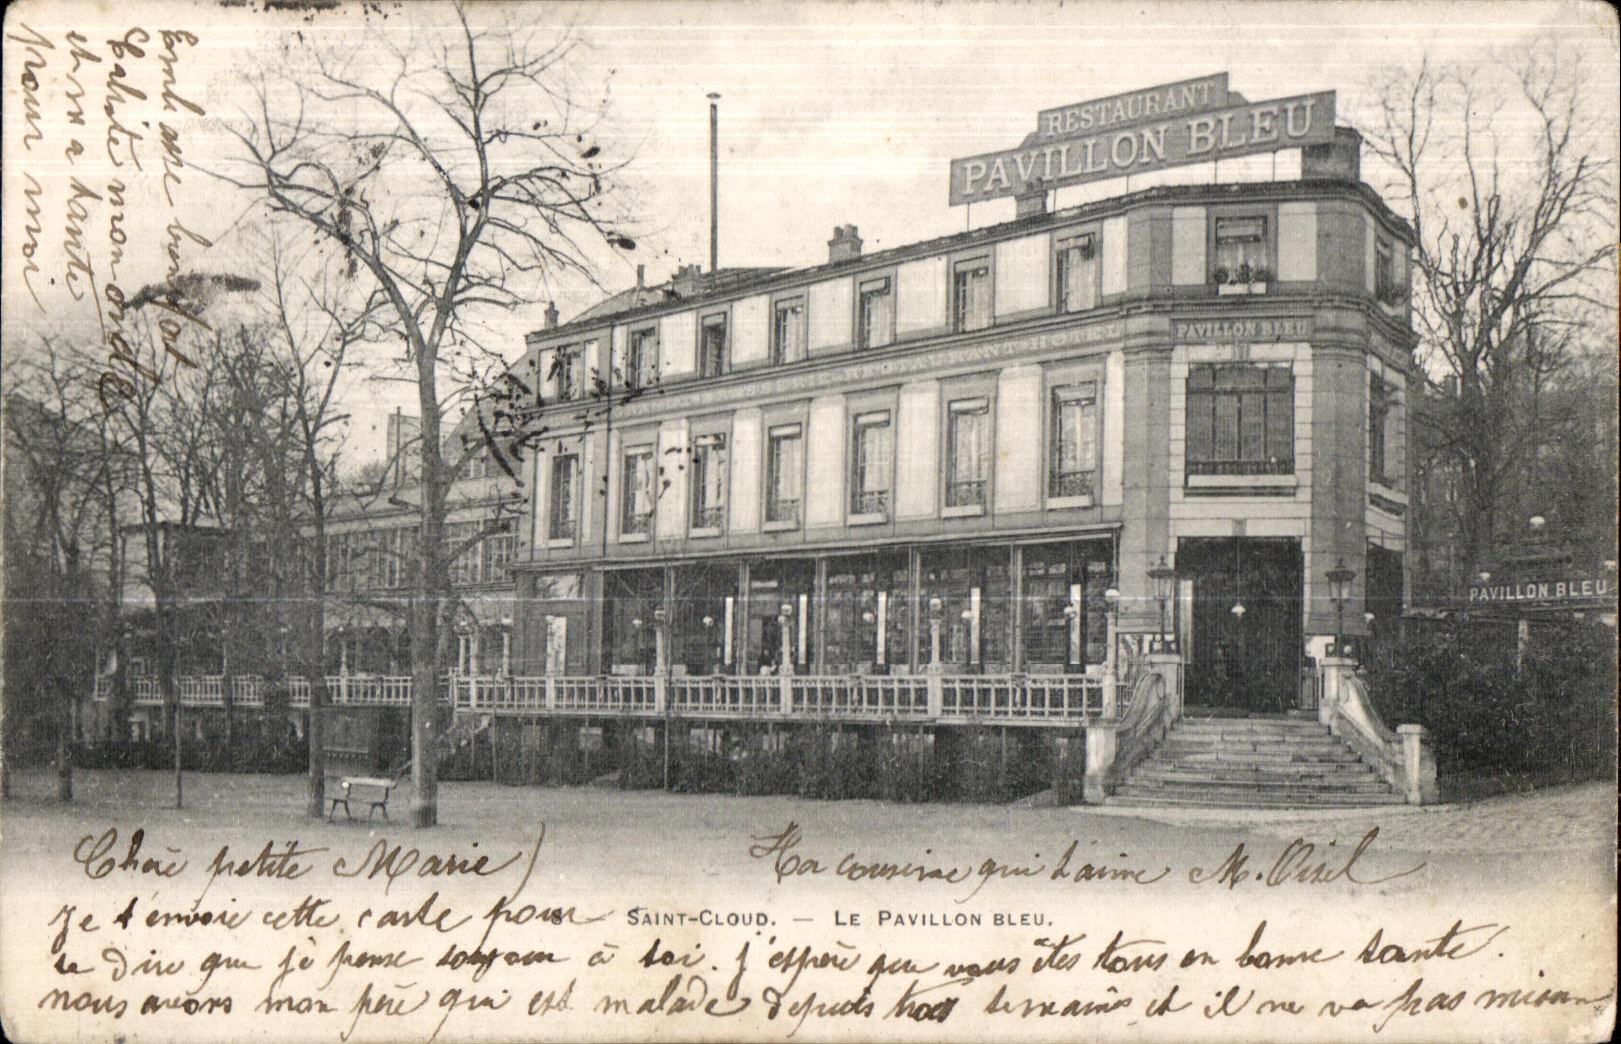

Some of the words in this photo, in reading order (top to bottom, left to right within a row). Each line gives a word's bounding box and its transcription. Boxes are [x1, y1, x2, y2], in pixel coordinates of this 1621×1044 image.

[7, 22, 55, 151] pour
[1046, 82, 1217, 138] RESTAURANT
[961, 124, 1169, 195] PAVILLON
[1187, 99, 1316, 157] BLEU
[22, 172, 54, 314] moi
[1176, 320, 1256, 338] PAVILLON
[1260, 319, 1308, 337] BLEU
[1469, 583, 1549, 602] PAVILLON
[1556, 578, 1608, 598] BLEU
[333, 838, 523, 896] Marie
[943, 956, 1021, 978] vous
[1179, 948, 1220, 969] en
[38, 988, 128, 1019] nous
[594, 973, 753, 1017] malade
